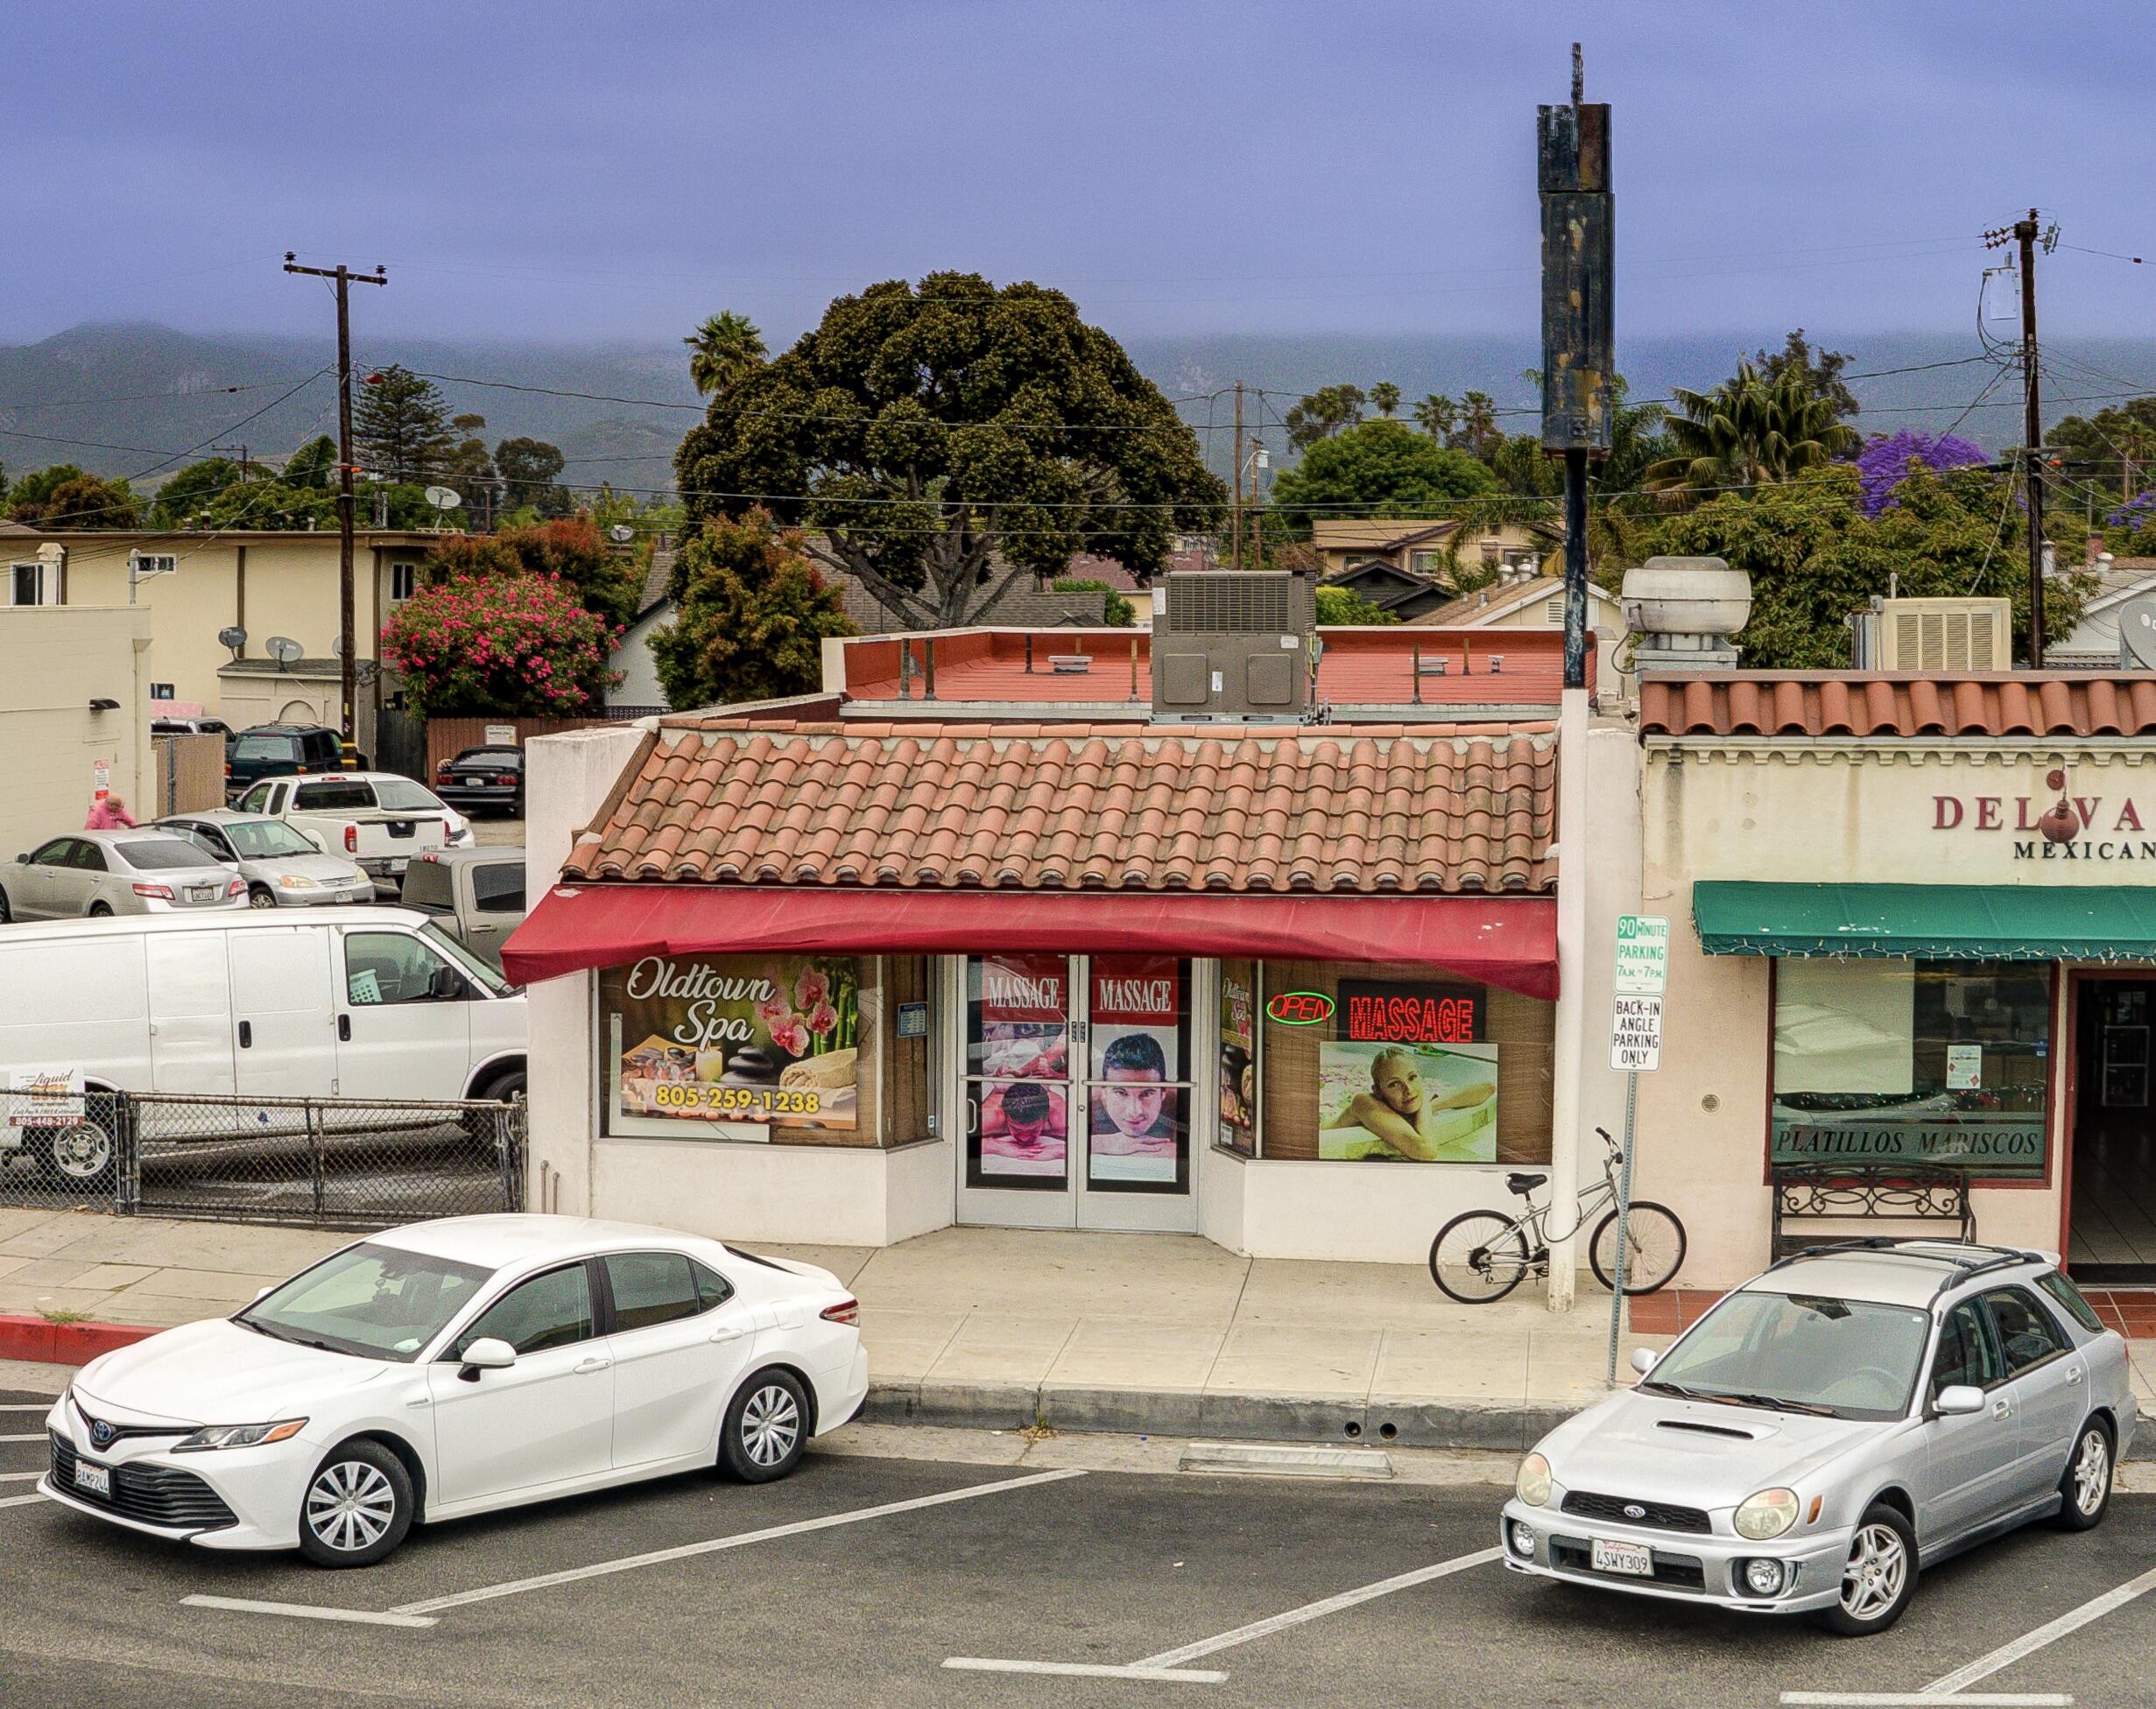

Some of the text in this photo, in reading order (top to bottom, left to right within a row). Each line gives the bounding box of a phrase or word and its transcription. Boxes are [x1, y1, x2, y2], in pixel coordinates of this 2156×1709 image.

[1932, 796, 2042, 831] DEL
[2013, 840, 2156, 860] MEXICAN
[1619, 918, 1666, 937] 90 MINUTE
[1618, 945, 1664, 960] PARKING
[627, 956, 776, 1002] Oldtown
[989, 976, 1060, 1008] MASSAGE
[1099, 980, 1172, 1011] MASSAGE
[1271, 995, 1330, 1021] OPEN
[1349, 996, 1474, 1043] MASSAGE
[1616, 1001, 1660, 1016] BACK-IN
[673, 999, 754, 1051] Spa
[1619, 1017, 1655, 1032] ANGLE
[1613, 1033, 1659, 1049] PARKING
[1621, 1049, 1649, 1065] ONLY
[656, 1085, 821, 1115] 805-259-1238
[1777, 1130, 2040, 1155] PLATILLOS MARISCOS
[1596, 1551, 1648, 1571] 4SWY309
